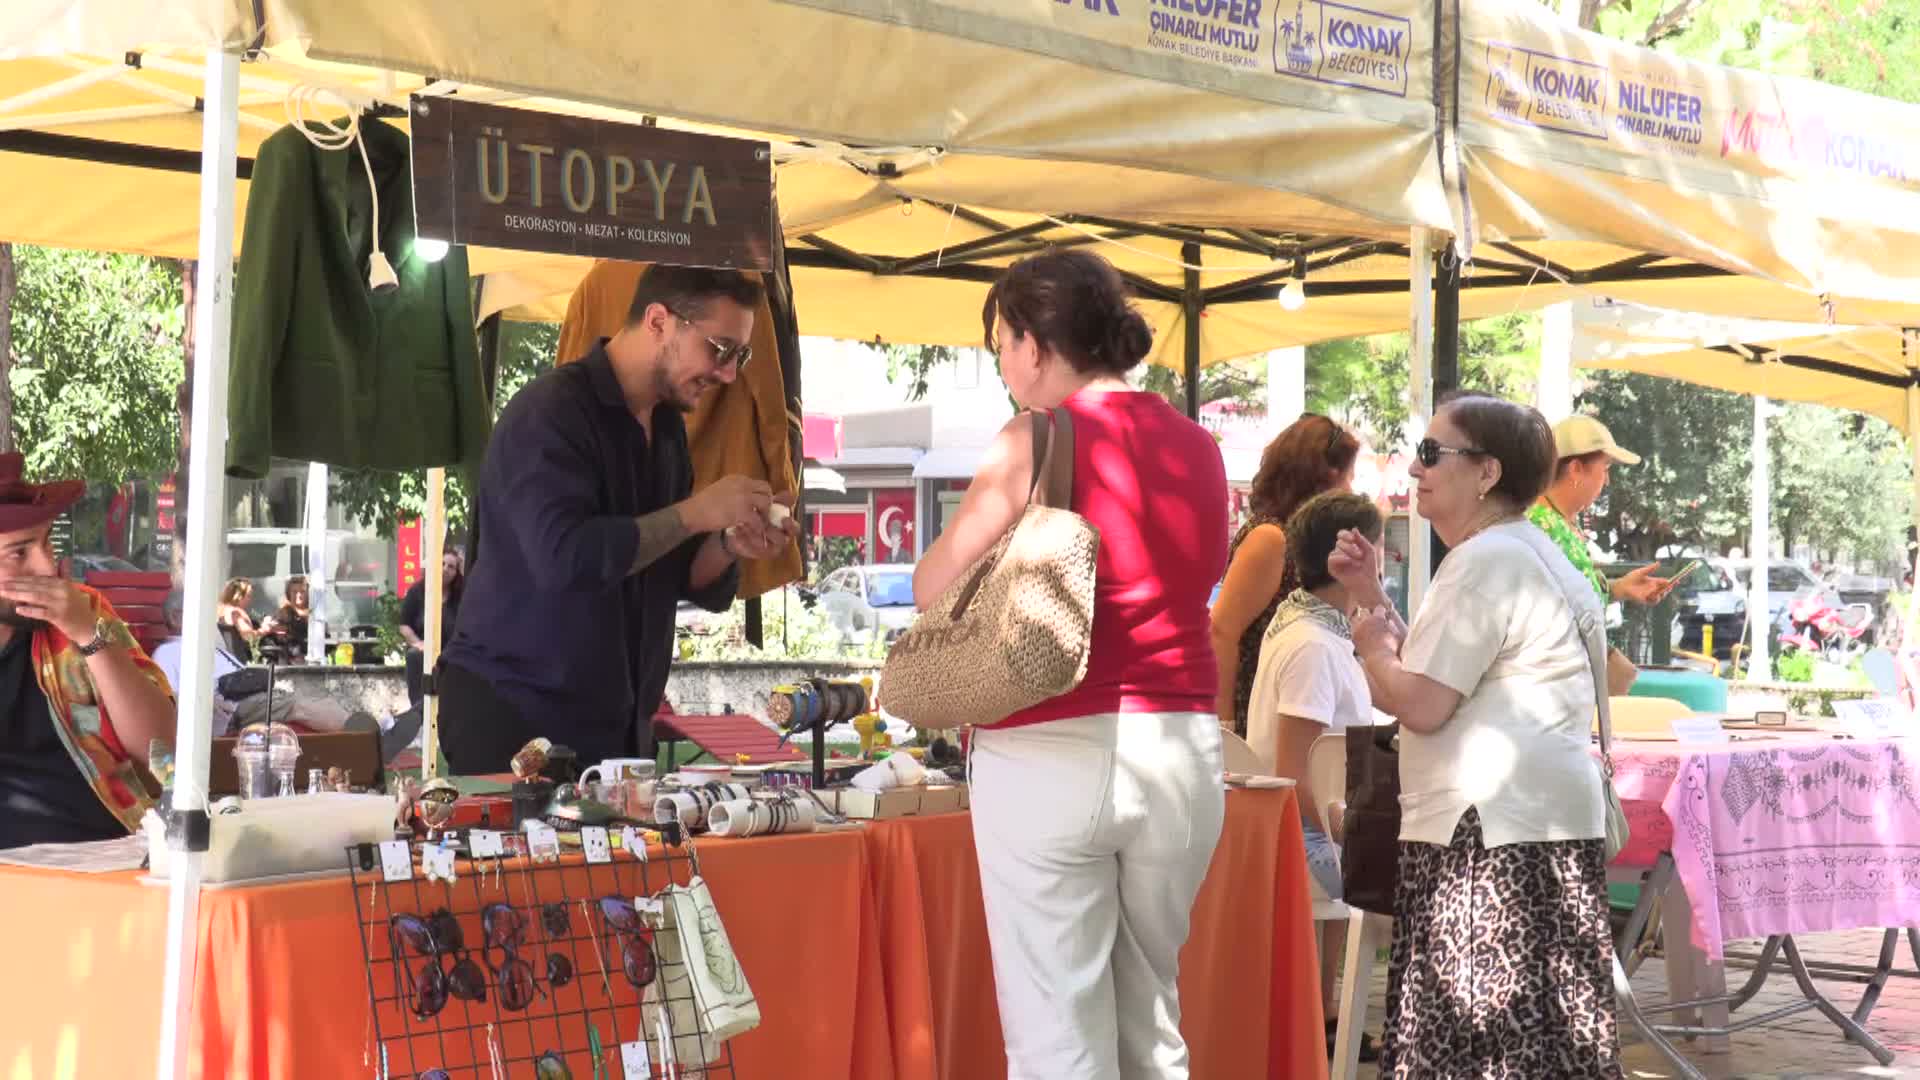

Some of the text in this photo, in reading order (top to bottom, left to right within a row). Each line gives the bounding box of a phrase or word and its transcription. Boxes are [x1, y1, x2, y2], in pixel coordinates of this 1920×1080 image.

[1147, 33, 1176, 50] KONAK
[1150, 11, 1260, 52] ÇINARLI MUTLU
[1328, 18, 1403, 58] KONAK
[1533, 66, 1600, 104] KONAK
[1663, 123, 1702, 144] MUTLU
[476, 126, 717, 226] ÜTOPYA
[505, 215, 690, 246] DEKORASYON MEZAT KOLEKSİYON
